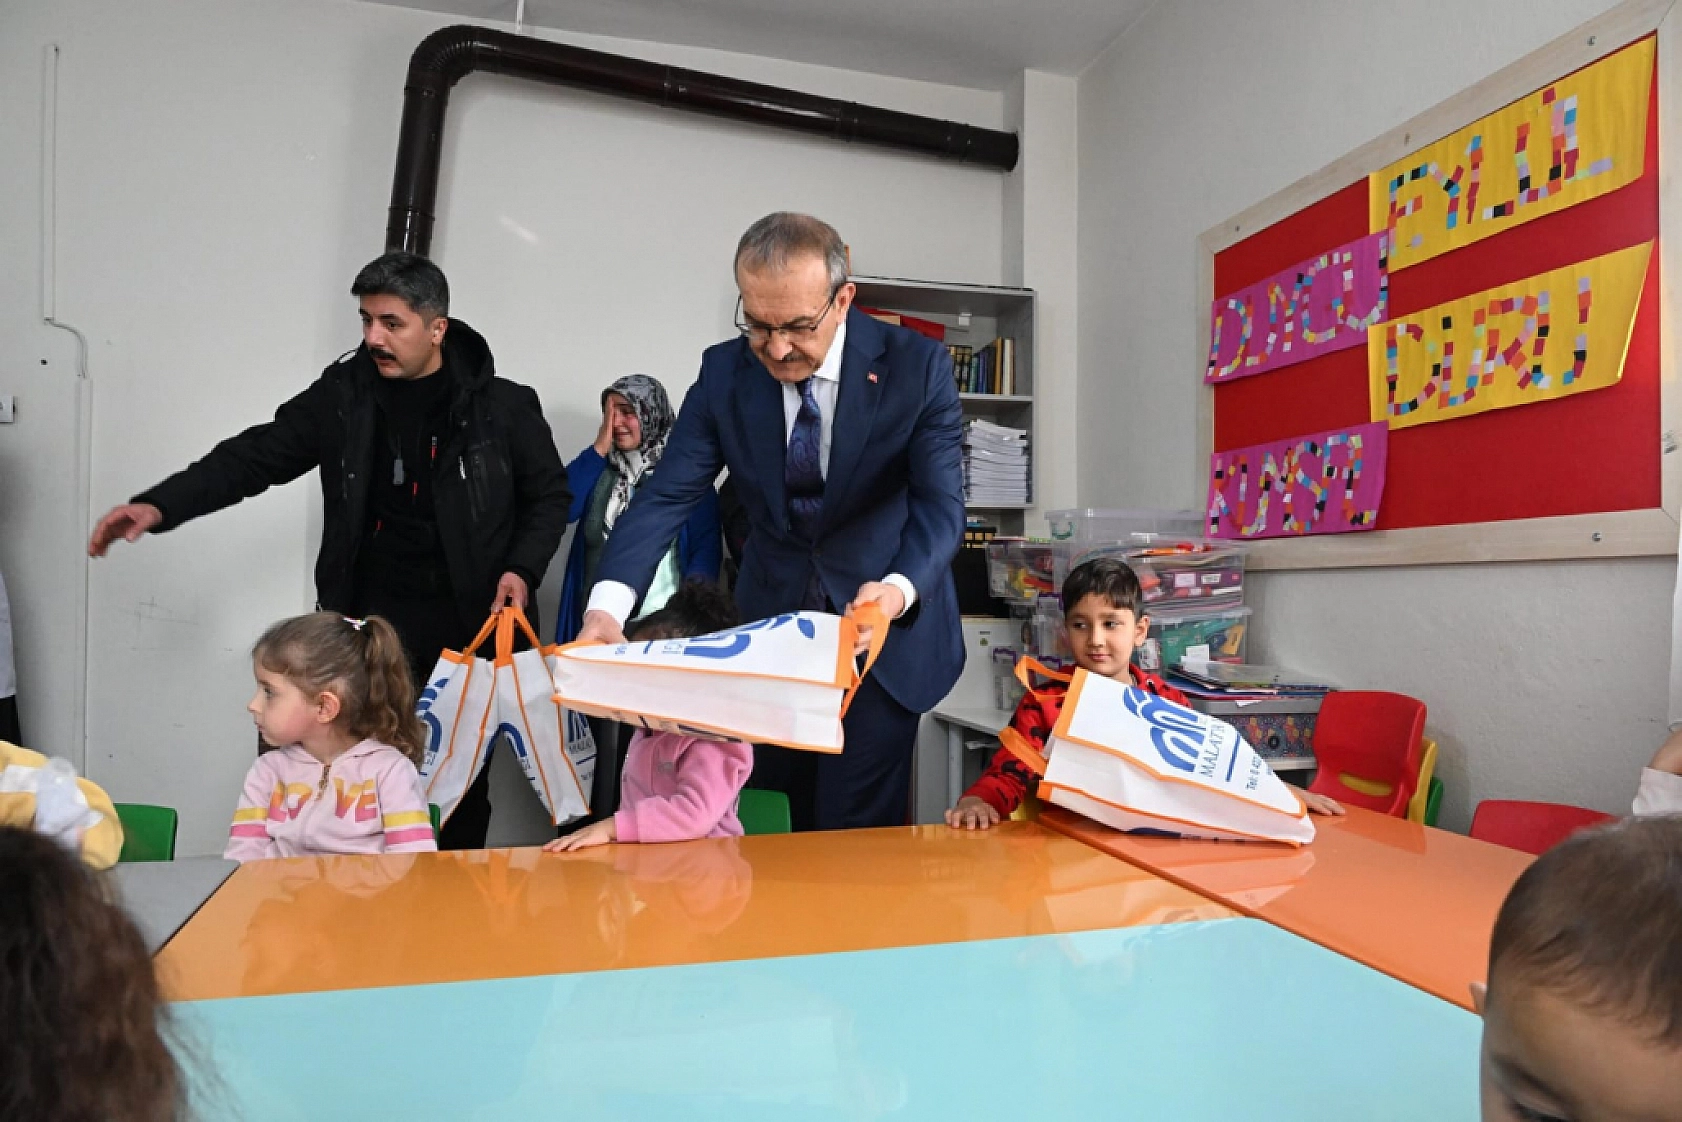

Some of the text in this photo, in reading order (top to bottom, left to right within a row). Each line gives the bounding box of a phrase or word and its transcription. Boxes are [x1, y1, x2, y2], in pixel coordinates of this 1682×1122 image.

[1208, 236, 1388, 376] DUYGU
[1387, 277, 1592, 416] DURU
[1209, 433, 1377, 535] KUMSAL
[269, 777, 377, 823] LOVE
